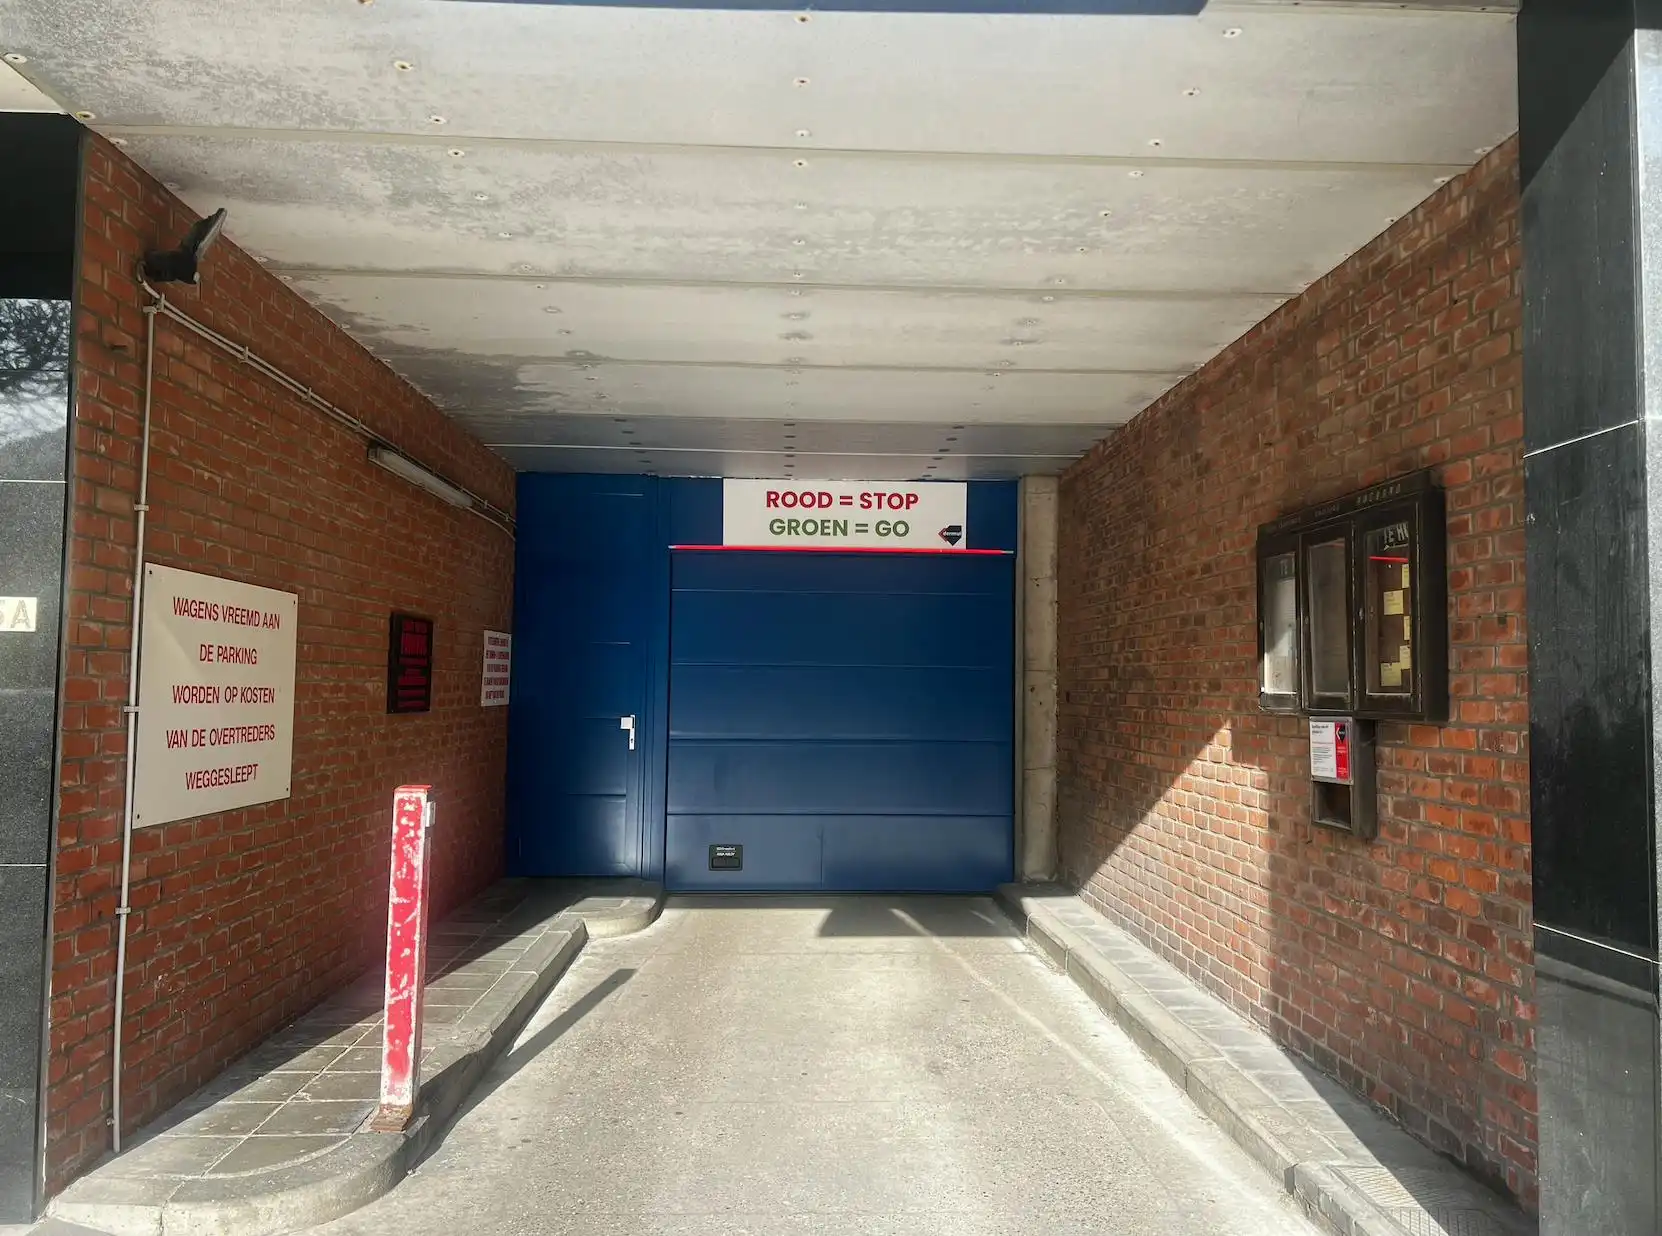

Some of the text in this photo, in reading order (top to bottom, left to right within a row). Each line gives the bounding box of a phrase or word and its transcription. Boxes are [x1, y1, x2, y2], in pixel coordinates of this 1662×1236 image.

[766, 491, 919, 511] ROOD = STOP
[769, 518, 910, 538] GROEN = GO
[0, 599, 31, 629] A
[173, 596, 280, 630] WAGENS VREEMD AAN
[200, 644, 257, 665] DE PARKING
[172, 685, 275, 704] WORDEN OP KOSTEN
[166, 724, 276, 749] VAN DE OVERTREDERS
[185, 763, 259, 790] WEGGESLEEPT
